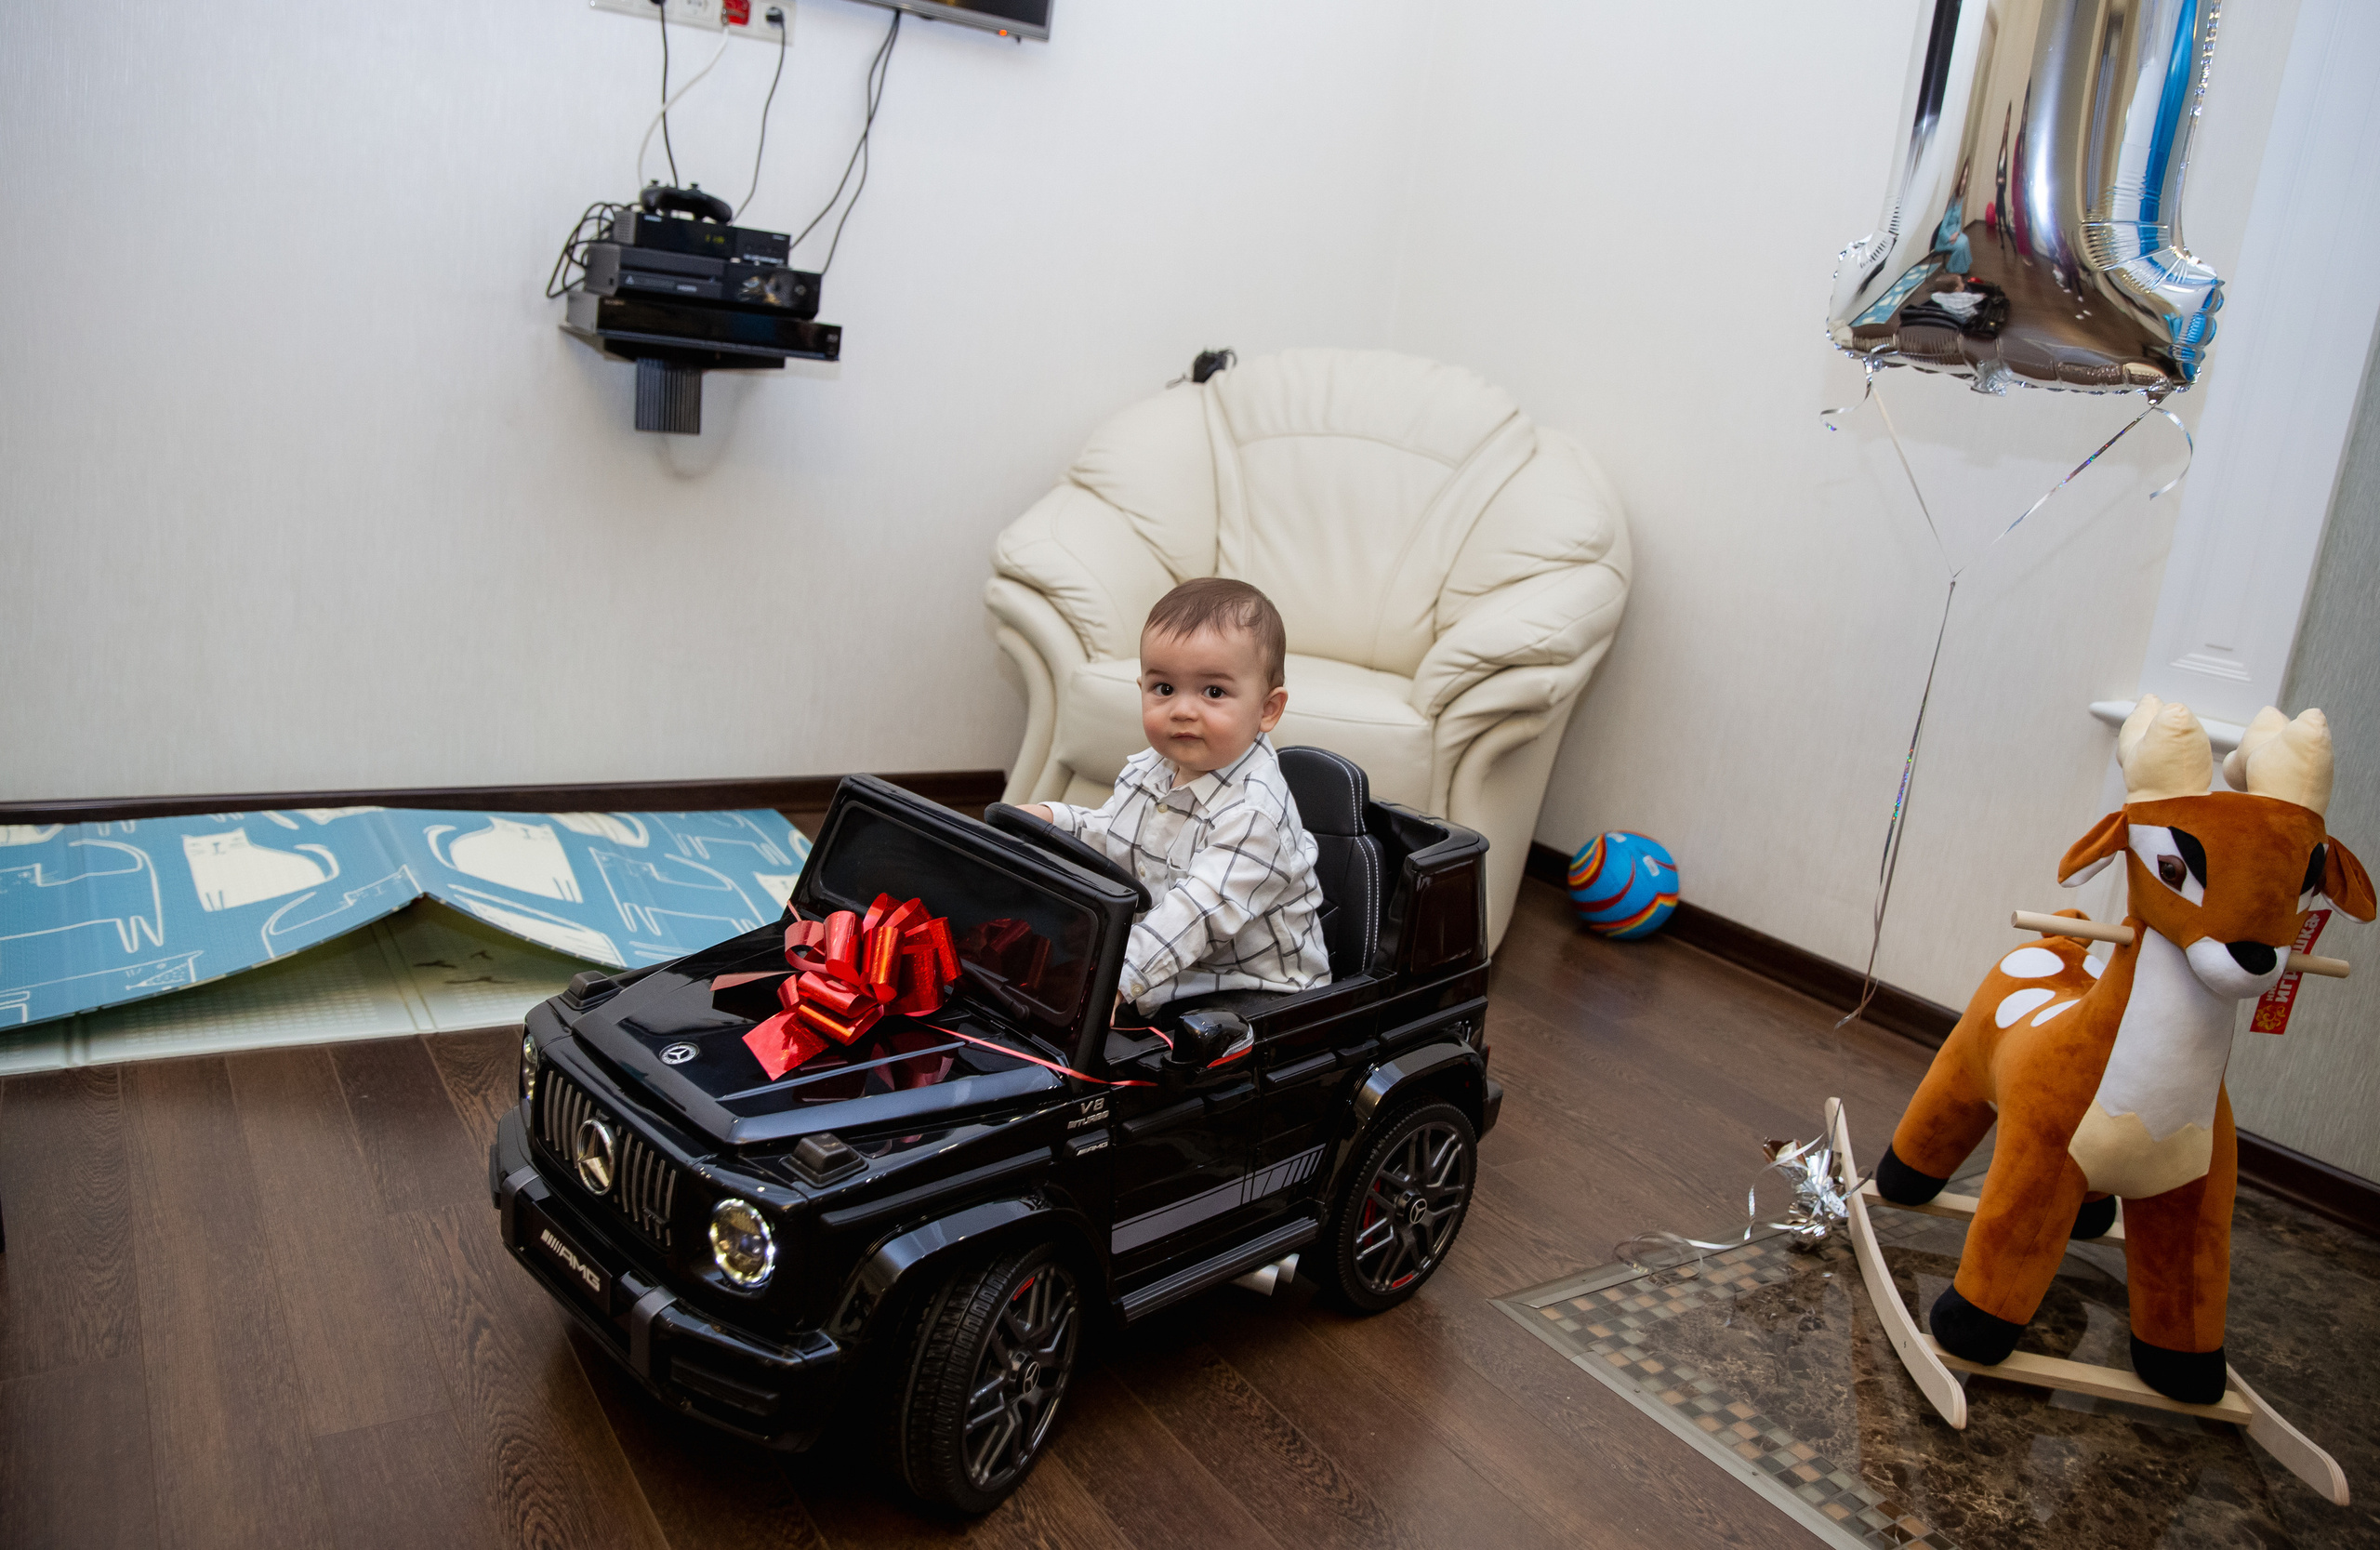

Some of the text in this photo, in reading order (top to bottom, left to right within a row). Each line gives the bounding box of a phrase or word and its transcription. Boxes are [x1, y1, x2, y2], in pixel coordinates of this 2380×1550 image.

[1080, 1097, 1105, 1115] V8
[1066, 1109, 1110, 1130] BITURBO
[558, 1245, 601, 1292] AMG
